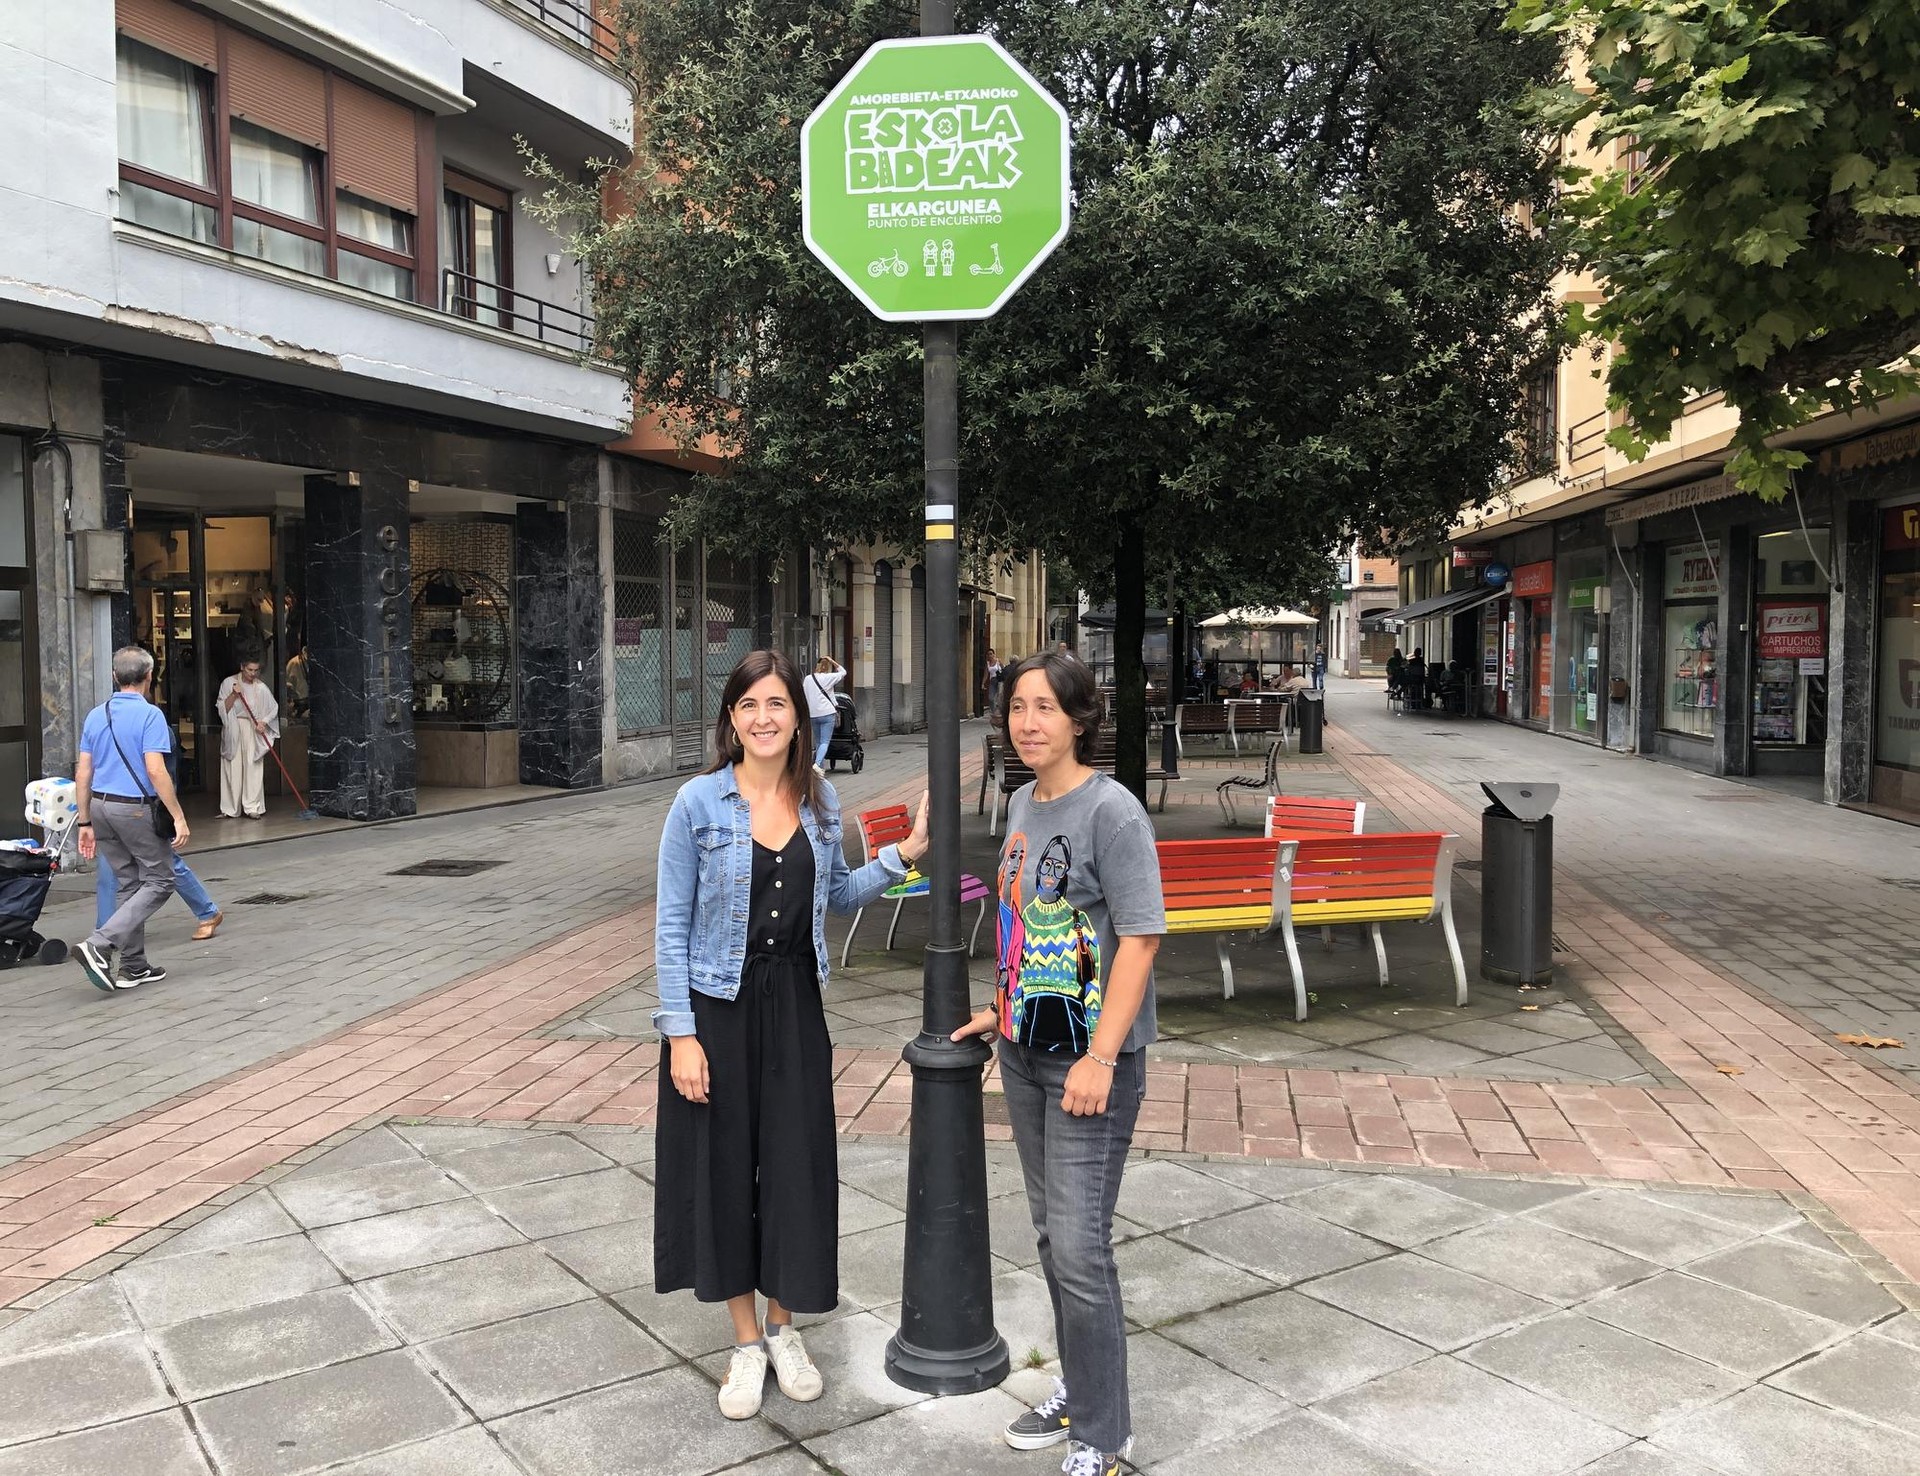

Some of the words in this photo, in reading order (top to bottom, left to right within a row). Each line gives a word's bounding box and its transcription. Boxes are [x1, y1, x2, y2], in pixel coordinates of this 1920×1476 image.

[850, 87, 1018, 106] AMOREBIETA-ETXANOko
[844, 104, 1024, 150] ESKOLA
[845, 144, 1023, 194] BIDEAK
[867, 199, 1002, 218] ELKARGUNEA
[867, 218, 907, 229] PUNTO
[911, 217, 927, 227] DE
[930, 214, 1002, 227] ENCUENTRO
[1454, 551, 1470, 559] FAST
[1761, 636, 1821, 646] CARTUCHOS
[1773, 646, 1821, 654] IMPRESORAS
